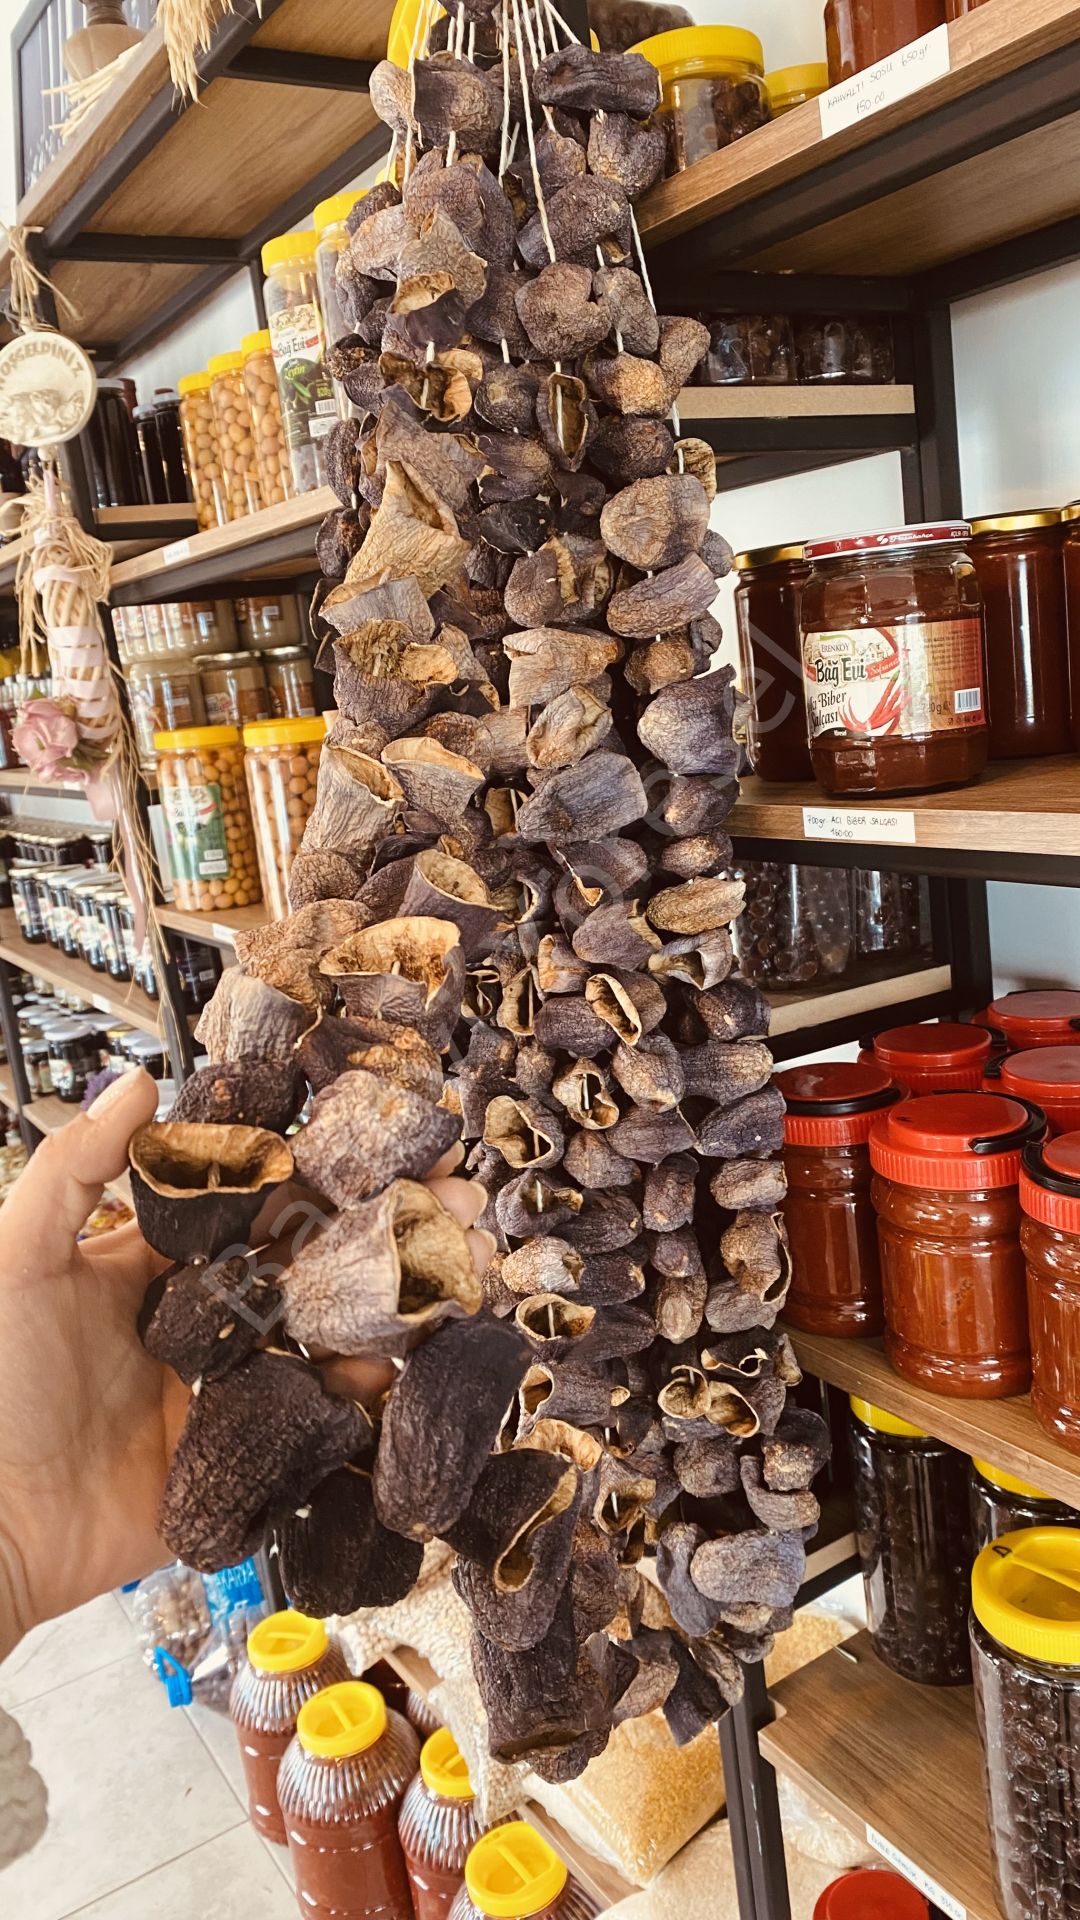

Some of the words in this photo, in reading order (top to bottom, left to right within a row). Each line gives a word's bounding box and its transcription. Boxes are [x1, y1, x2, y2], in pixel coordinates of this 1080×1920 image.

[827, 81, 865, 109] KAHVALTI
[870, 64, 894, 83] SOSU
[815, 659, 839, 687] Bağ
[841, 657, 866, 681] Evi
[818, 691, 847, 708] Biber
